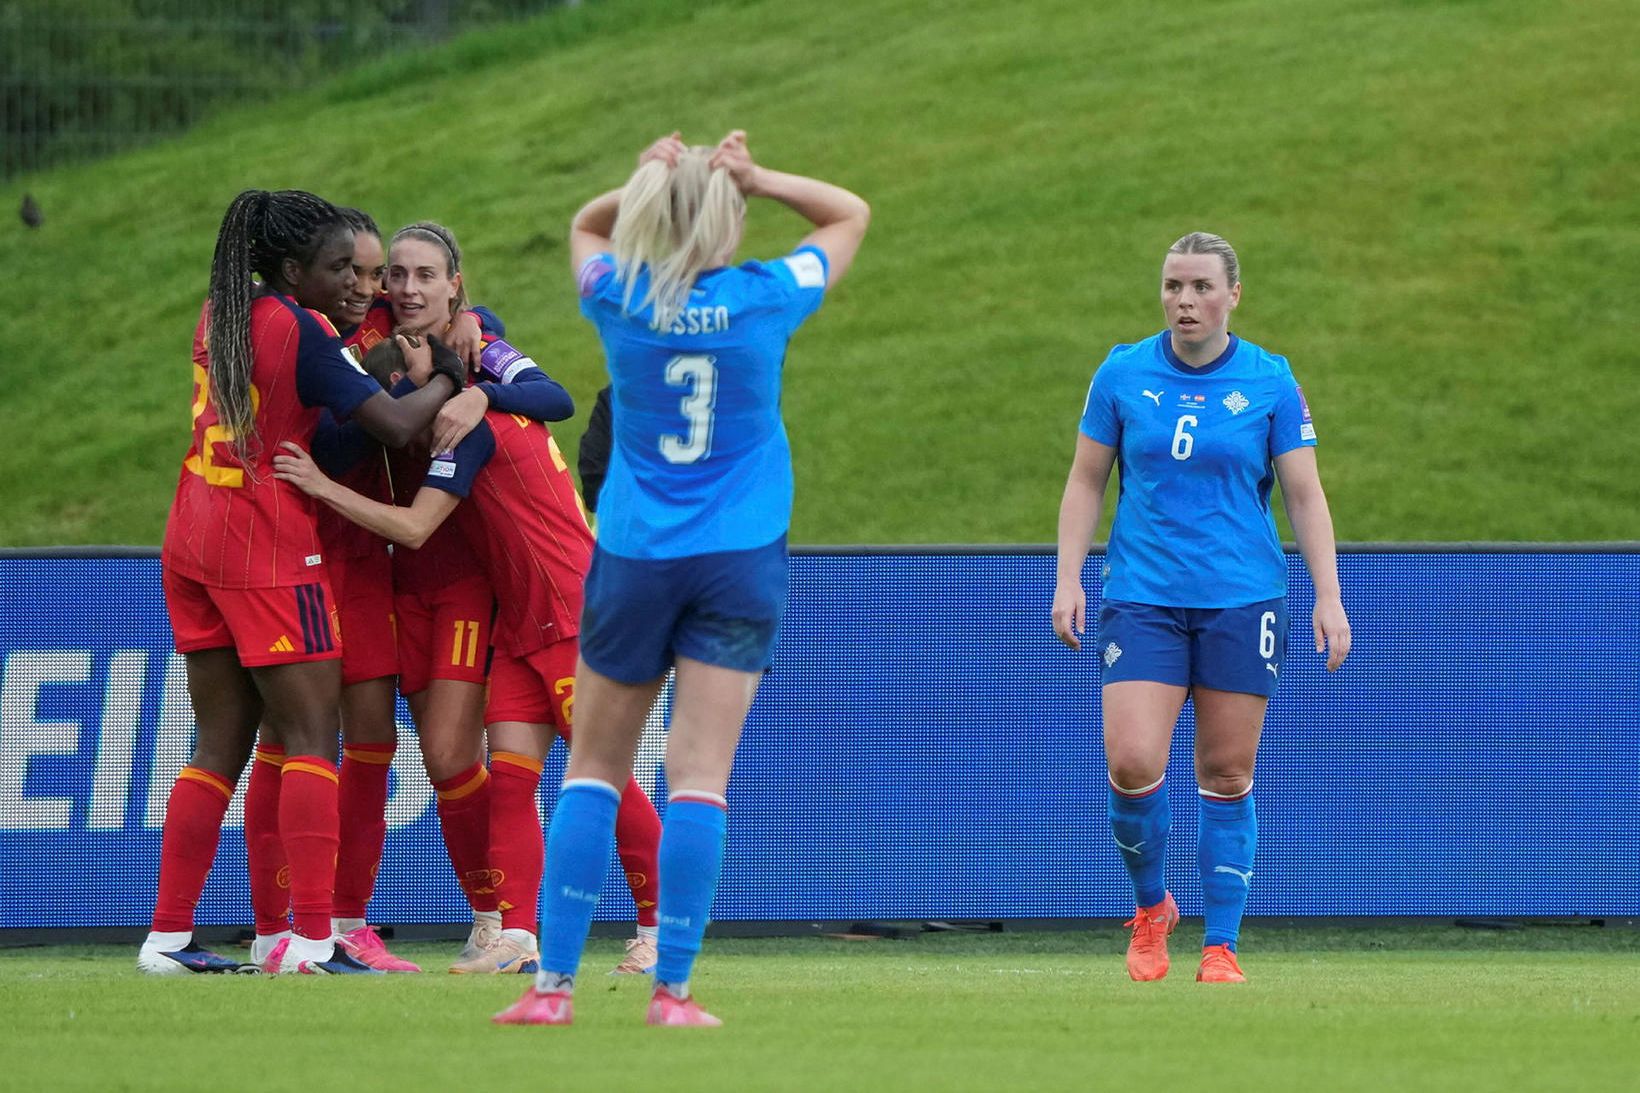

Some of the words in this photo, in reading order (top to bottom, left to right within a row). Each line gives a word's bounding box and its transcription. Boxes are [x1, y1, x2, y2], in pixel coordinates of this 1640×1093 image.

[658, 355, 719, 464] 3
[1171, 414, 1198, 461] 6
[451, 620, 480, 668] 11
[1258, 611, 1276, 659] 6
